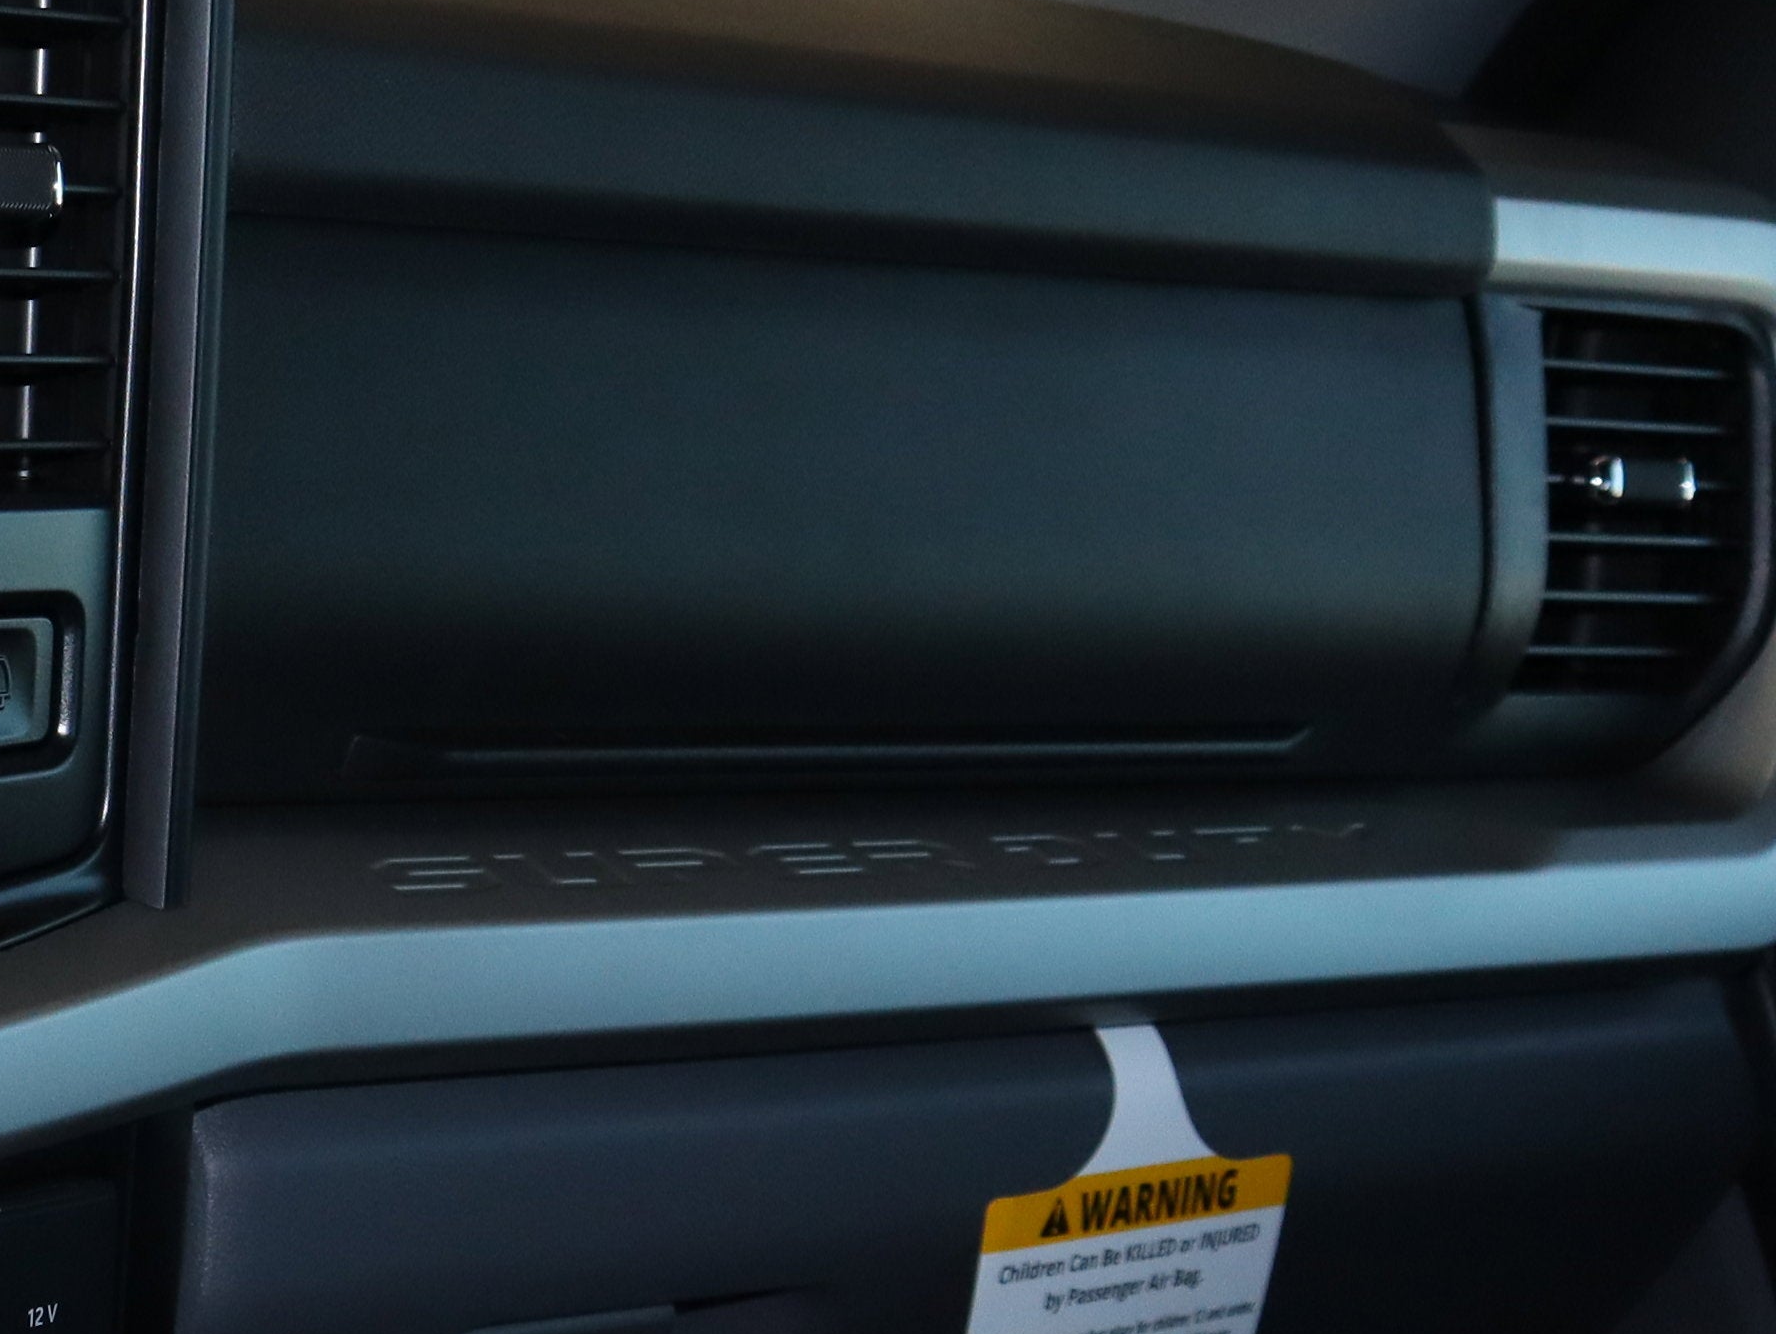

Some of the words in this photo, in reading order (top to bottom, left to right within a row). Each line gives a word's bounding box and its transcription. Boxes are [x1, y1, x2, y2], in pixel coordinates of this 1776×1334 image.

[1080, 1169, 1239, 1233] WARNING
[997, 1256, 1065, 1286] Children
[1069, 1252, 1099, 1273] Can
[1102, 1250, 1123, 1269] Be
[1125, 1238, 1176, 1265] KILLED
[1198, 1223, 1261, 1252] INJURED
[1043, 1289, 1065, 1315] by
[1068, 1276, 1146, 1308] Passenger
[1149, 1271, 1173, 1291] Air
